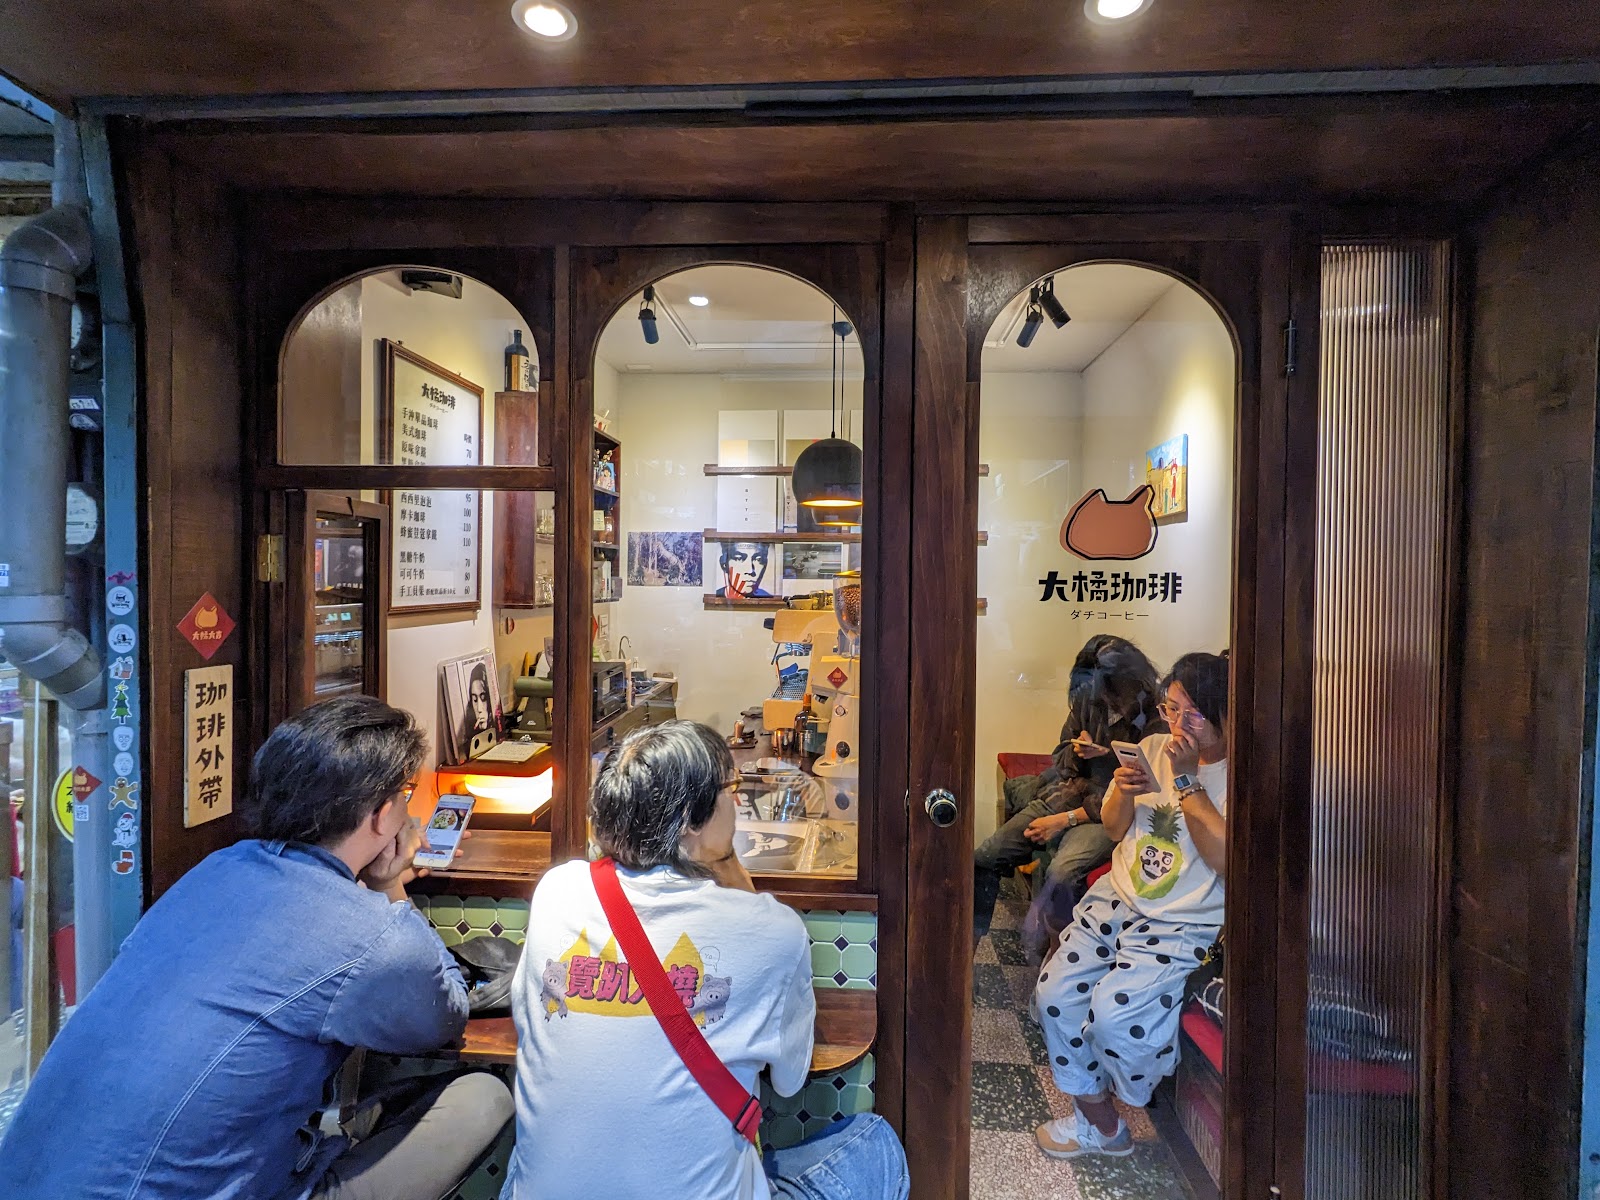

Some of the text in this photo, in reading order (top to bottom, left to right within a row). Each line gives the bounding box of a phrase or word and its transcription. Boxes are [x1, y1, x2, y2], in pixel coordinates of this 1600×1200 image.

[400, 568, 425, 581] 可可牛奶
[1038, 570, 1183, 603] 大橘珈琲
[1070, 609, 1149, 621] ダチコーヒー
[194, 681, 228, 809] 珈琲外帶
